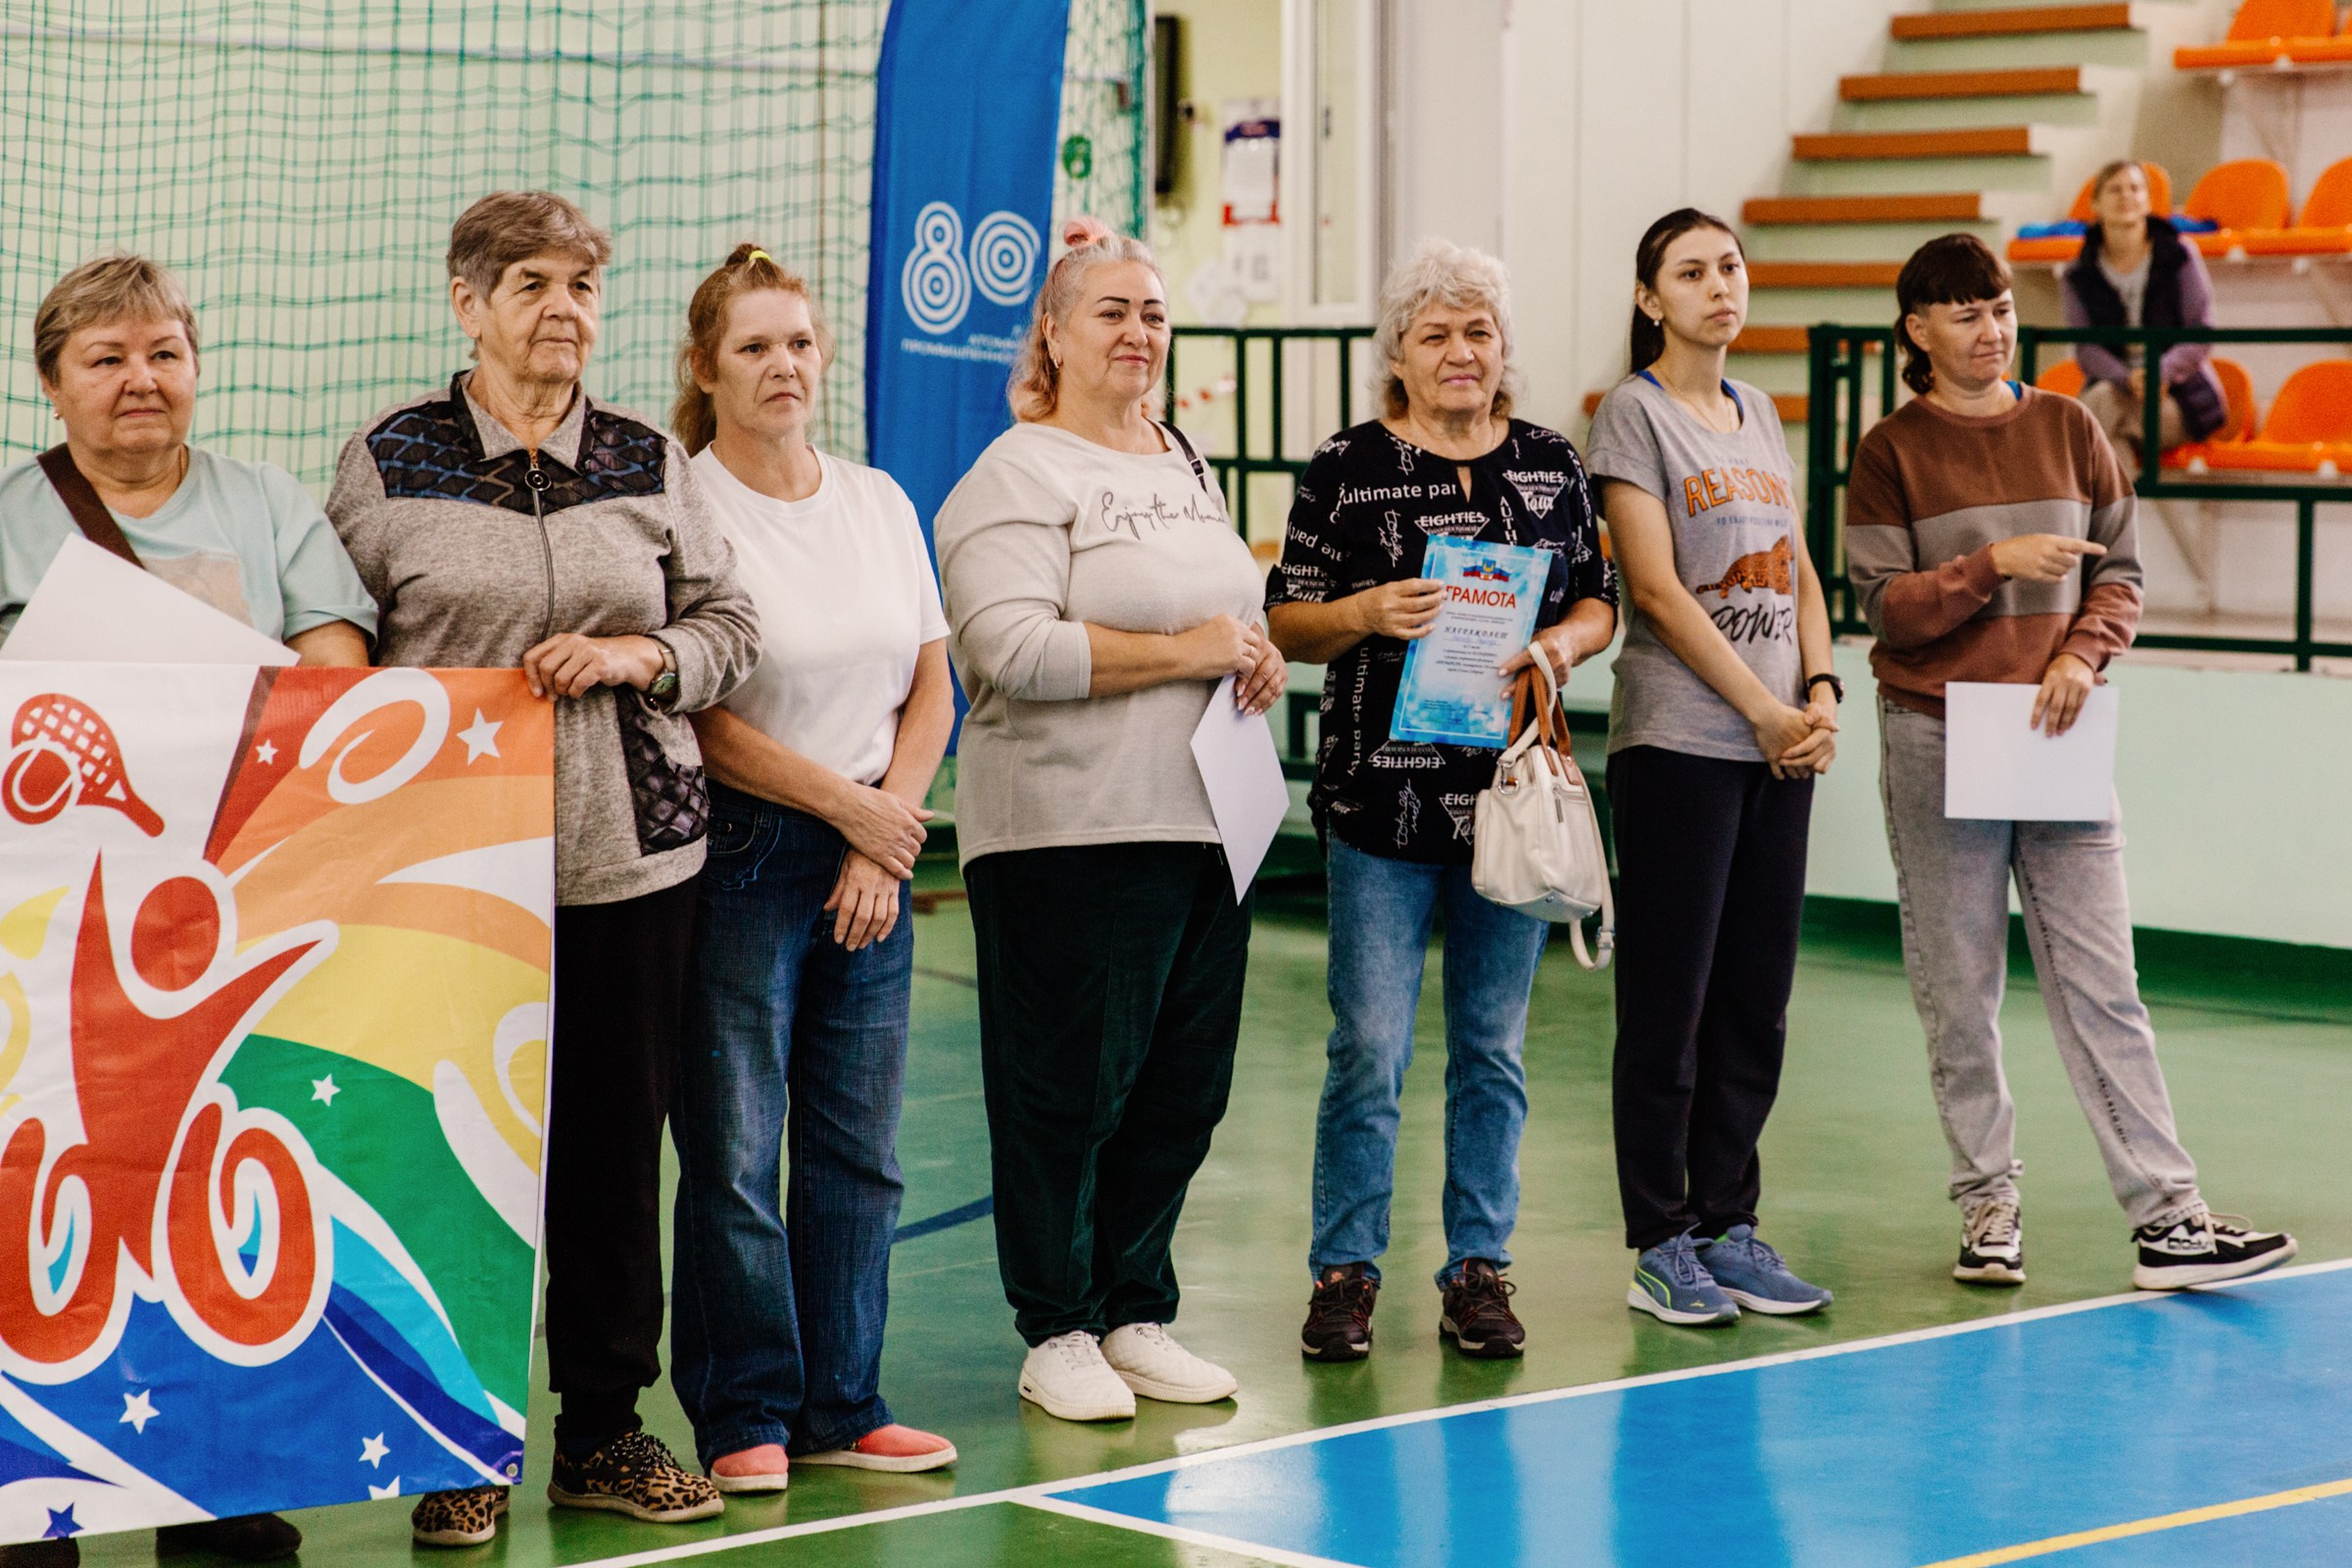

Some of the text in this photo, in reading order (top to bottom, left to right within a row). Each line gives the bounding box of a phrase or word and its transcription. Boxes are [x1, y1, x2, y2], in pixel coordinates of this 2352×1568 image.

[902, 201, 1041, 334] 80
[1343, 483, 1422, 505] ultimate
[1419, 511, 1487, 527] EIGHTIES
[1445, 585, 1516, 610] ГРАМОТА
[1352, 648, 1370, 722] ultimate
[1372, 756, 1440, 768] EIGHTIES
